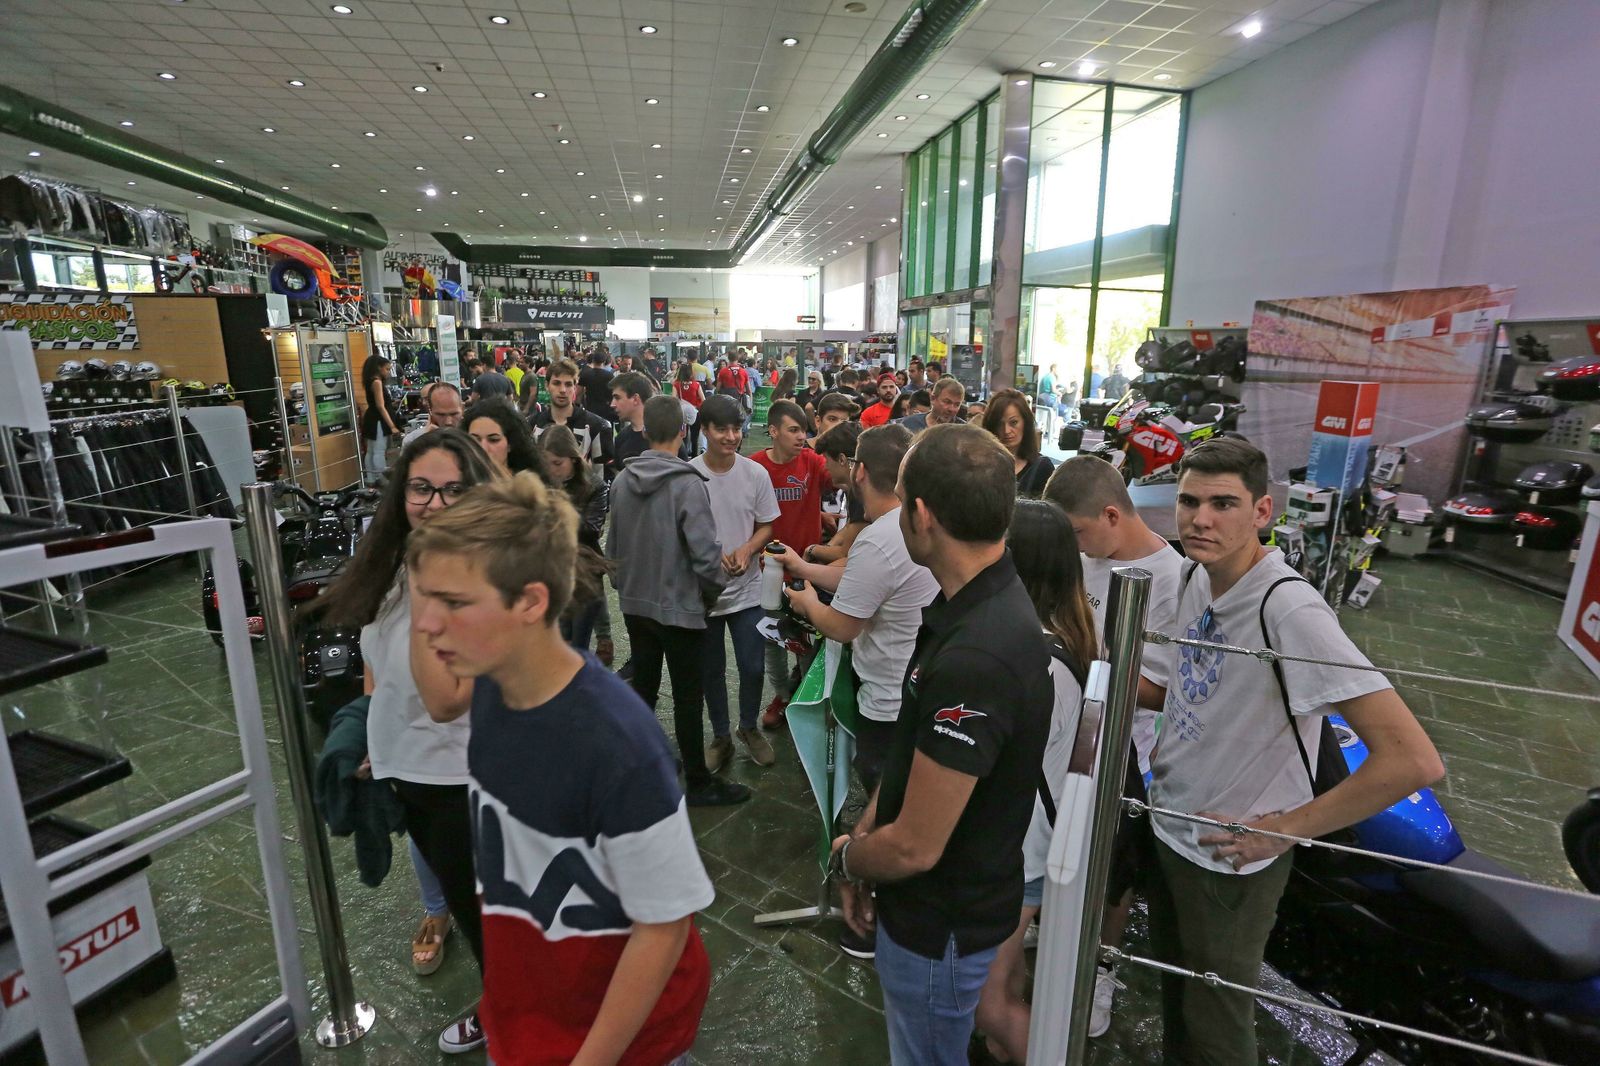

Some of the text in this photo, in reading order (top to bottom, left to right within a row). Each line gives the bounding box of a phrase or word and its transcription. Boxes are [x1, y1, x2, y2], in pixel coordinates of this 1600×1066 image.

[1321, 415, 1347, 429] GIVI
[1132, 430, 1179, 456] GIVI
[774, 487, 802, 501] UMA
